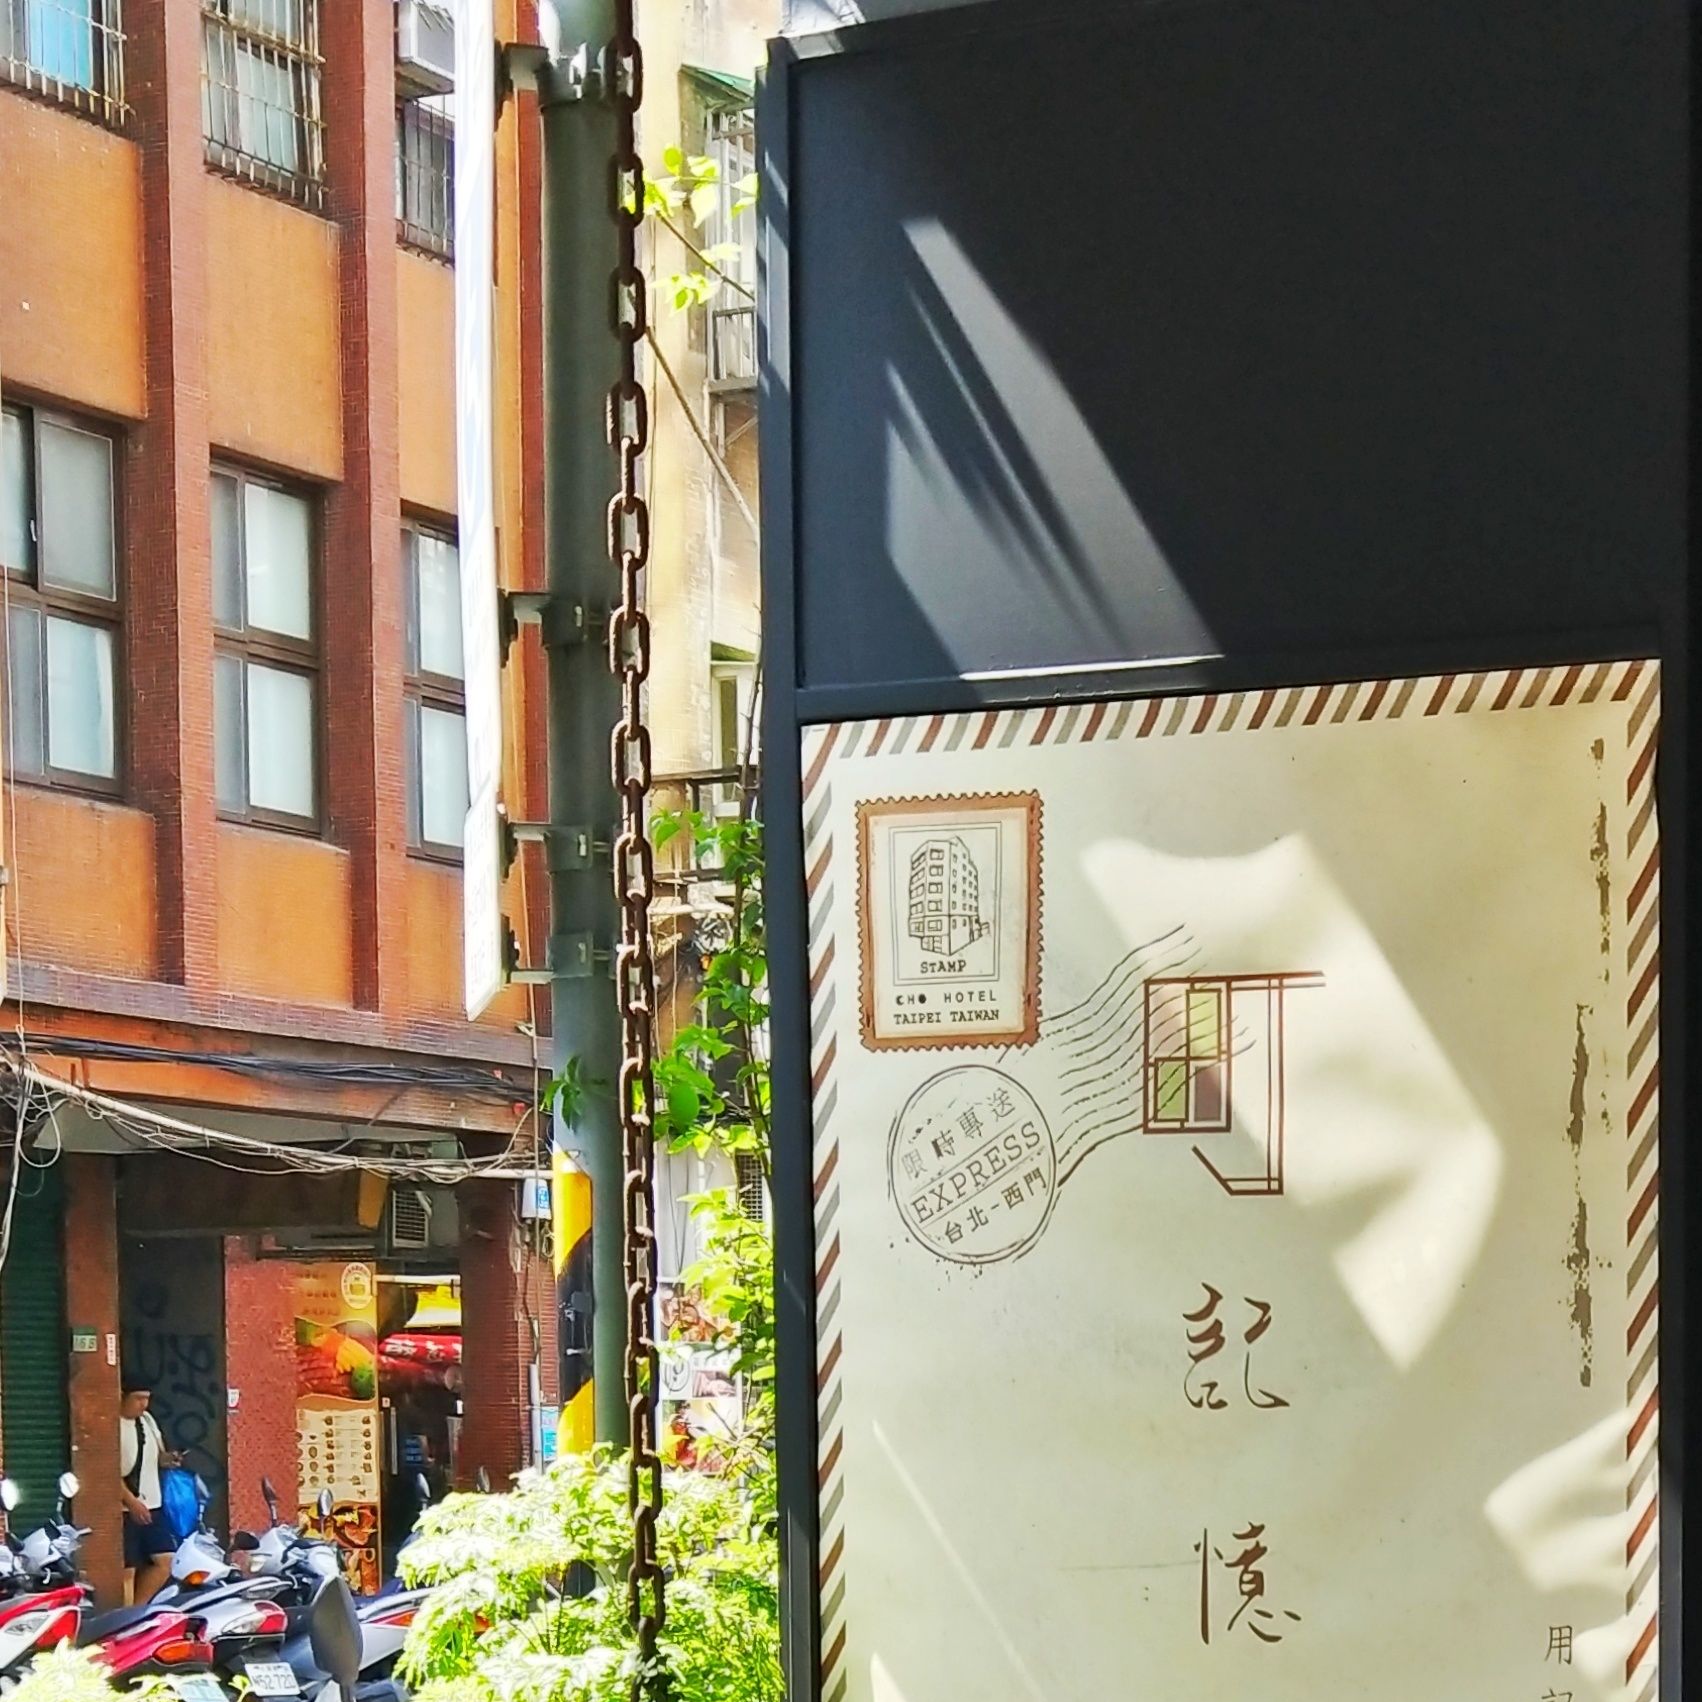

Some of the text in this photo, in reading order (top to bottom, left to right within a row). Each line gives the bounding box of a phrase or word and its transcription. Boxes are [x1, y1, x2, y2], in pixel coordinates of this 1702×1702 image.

[920, 959, 967, 974] STAMP
[943, 989, 997, 1003] HOTEL
[893, 1009, 1000, 1025] TAIPEI TAIWAN
[900, 1087, 1016, 1182] 限時專送
[910, 1120, 1041, 1224] EXPRESS
